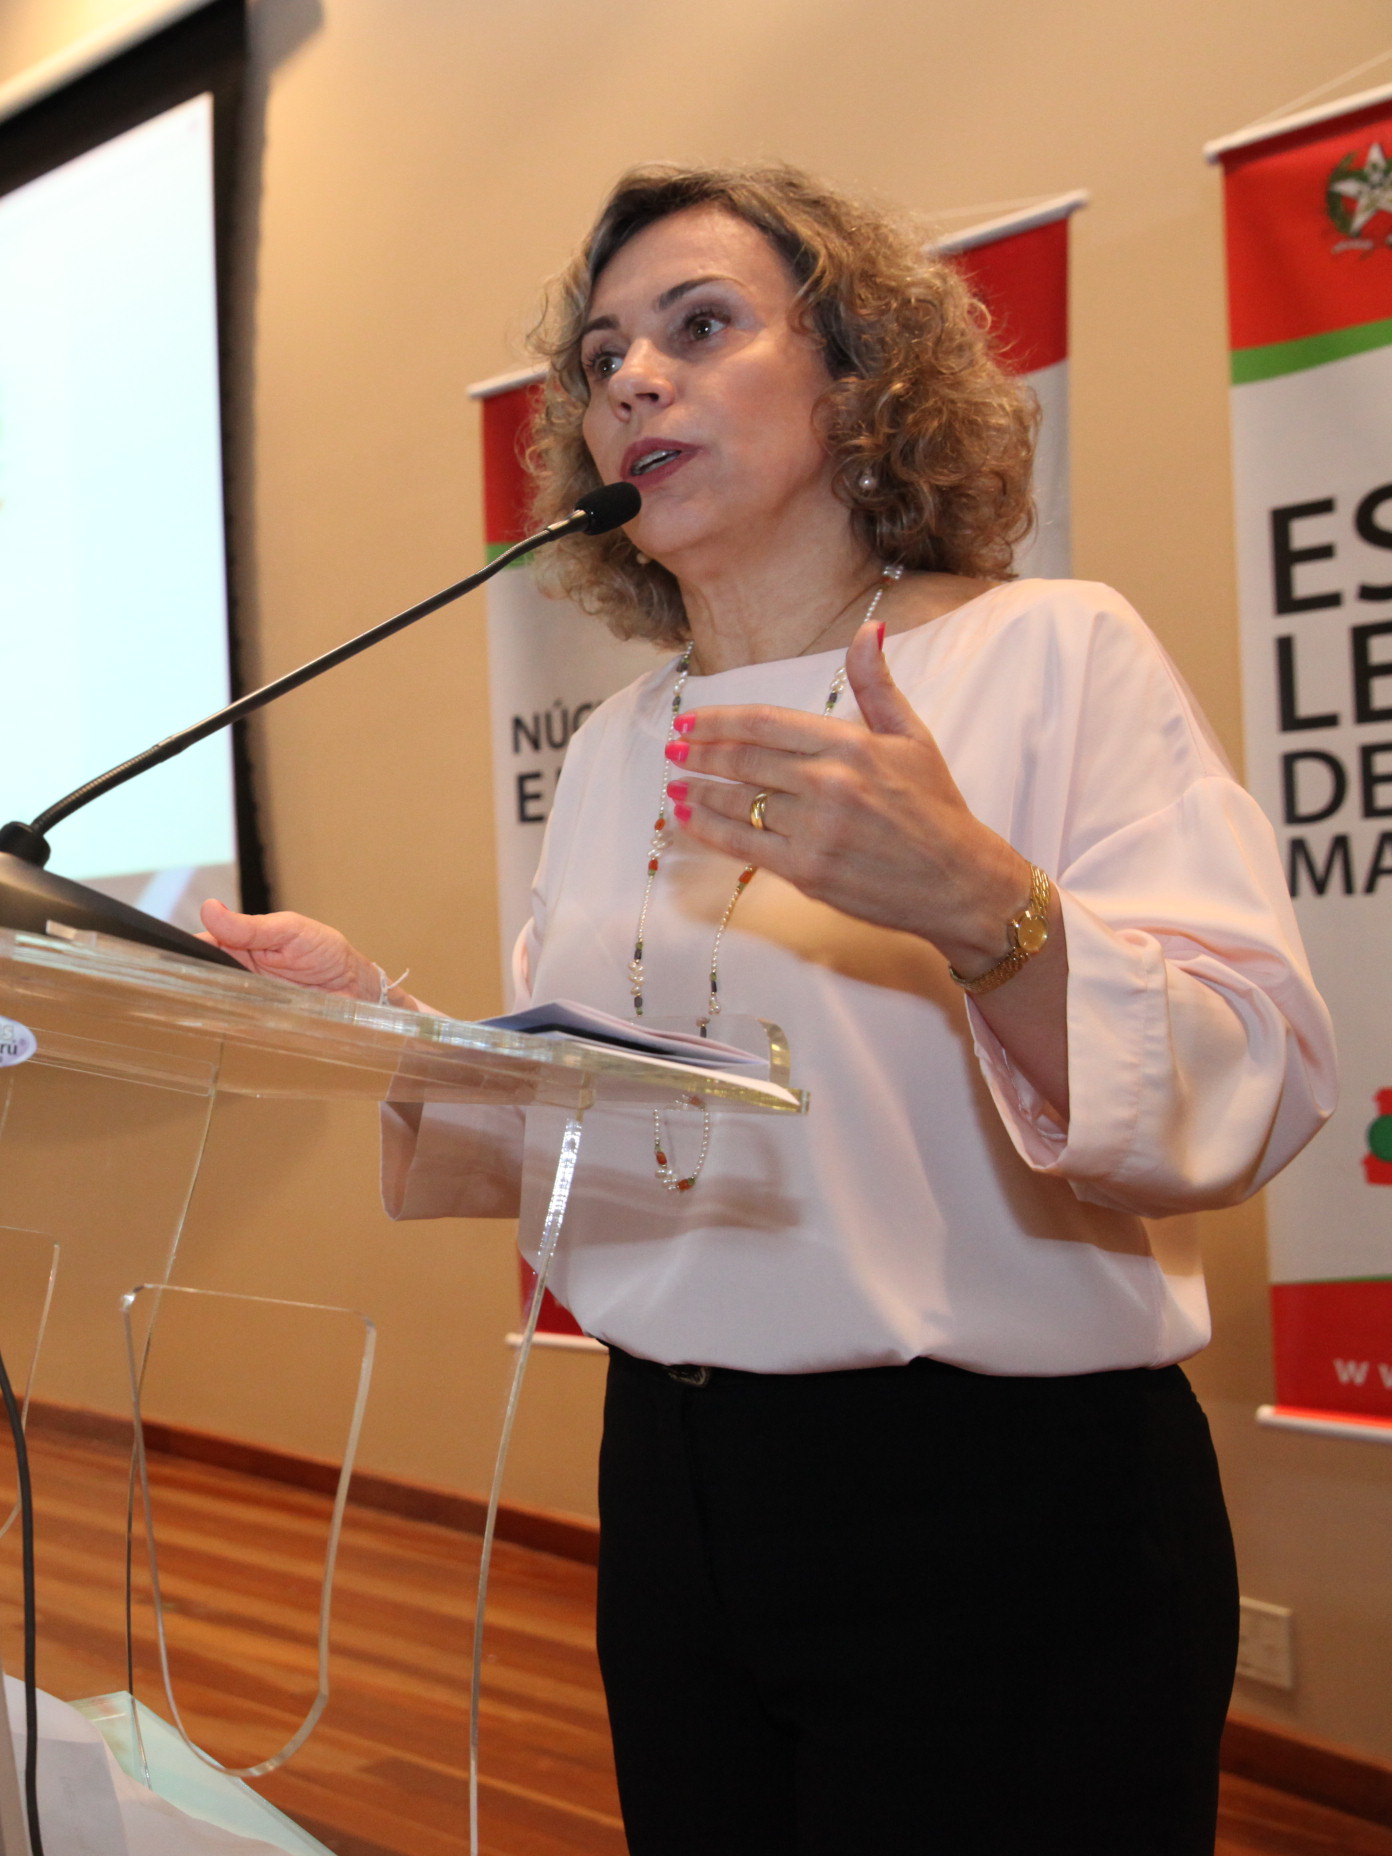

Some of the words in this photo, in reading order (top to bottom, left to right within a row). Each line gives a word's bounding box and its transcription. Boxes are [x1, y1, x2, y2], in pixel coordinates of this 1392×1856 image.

[1275, 622, 1392, 732] LE
[512, 699, 604, 753] NÚC
[1282, 742, 1392, 824] DE
